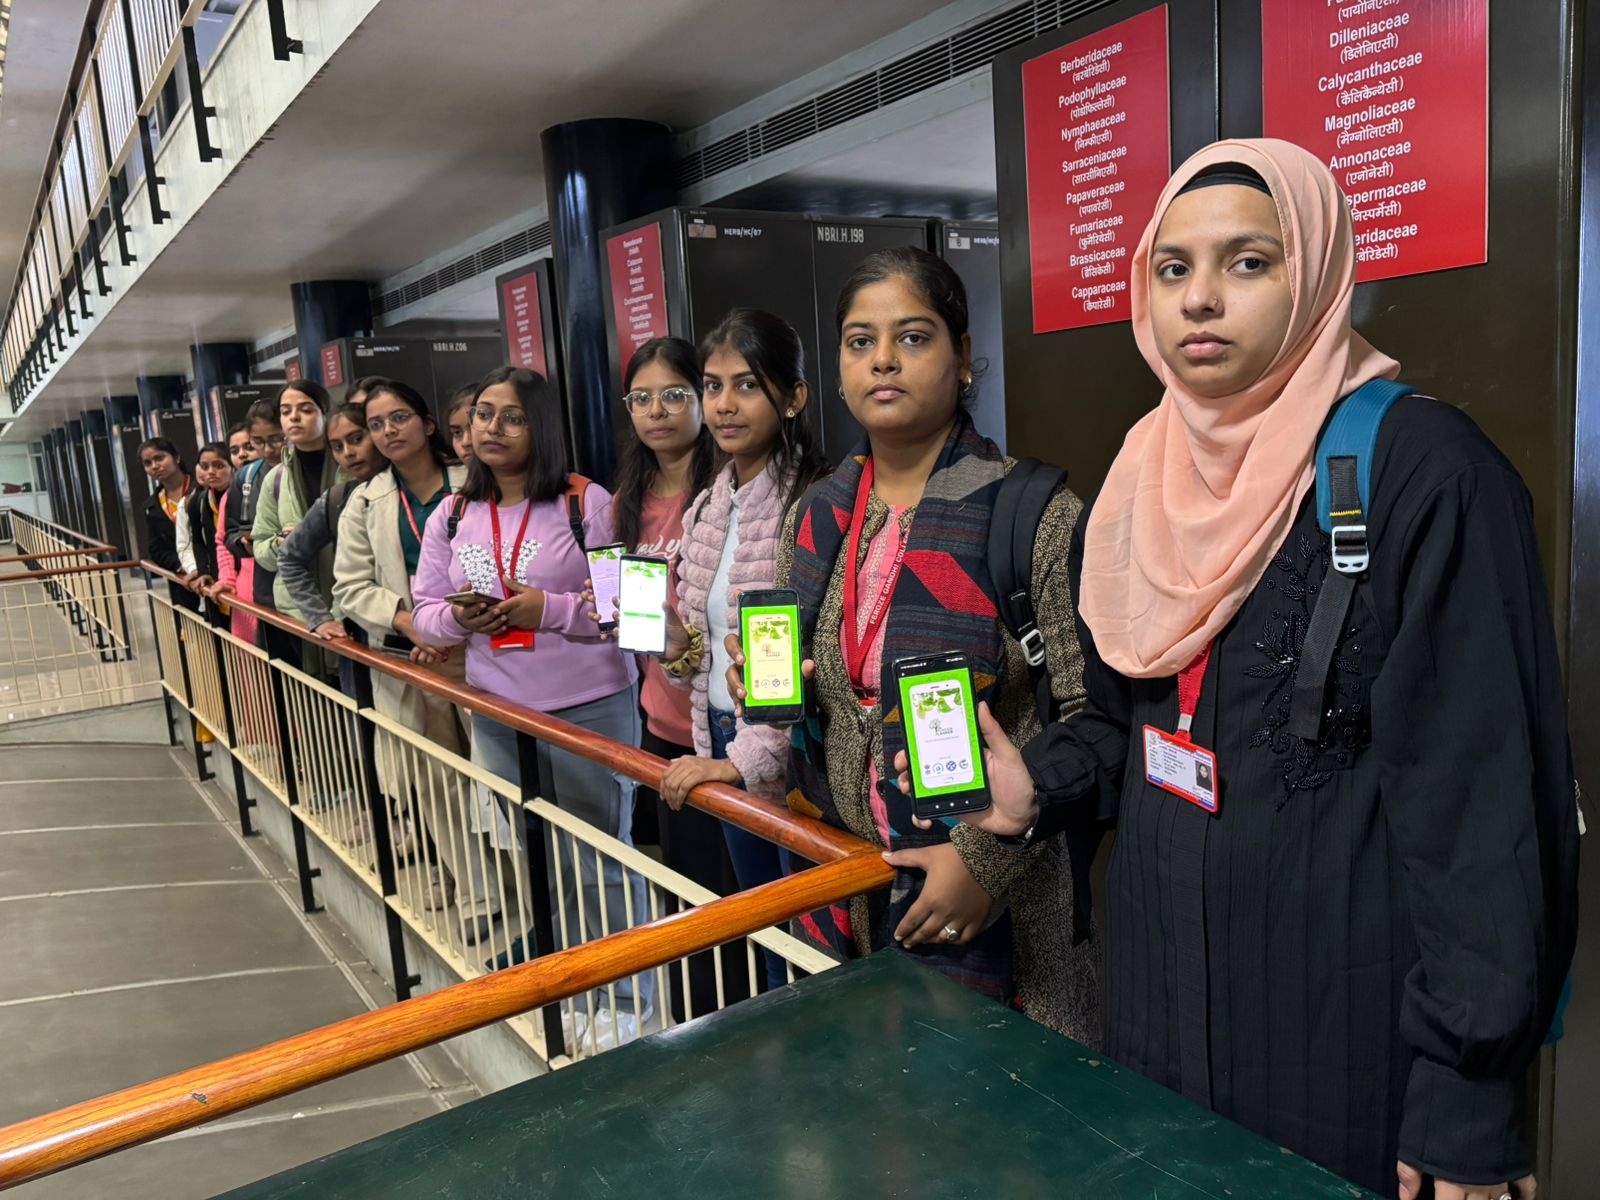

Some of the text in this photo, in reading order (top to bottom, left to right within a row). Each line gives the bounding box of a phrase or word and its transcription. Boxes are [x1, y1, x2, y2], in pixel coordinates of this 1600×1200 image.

[1329, 12, 1410, 48] Dilleniaceae
[1060, 42, 1123, 74] Berberidaceae
[1340, 33, 1399, 65] (डिलेनिएसी)
[1318, 52, 1423, 92] Calycanthaceae
[1058, 75, 1127, 109] Podophyllaceae
[1061, 111, 1126, 142] Nymphaeaceae
[1325, 97, 1416, 132] Magnoliaceae
[1337, 118, 1404, 149] (मैग्नोलिएसी)
[1062, 145, 1127, 173] Sarraceniaceae
[1329, 141, 1412, 171] Annonaceae
[1346, 162, 1394, 186] (एनोनेसी)
[1066, 181, 1125, 205] Papaveraceae
[1345, 178, 1426, 208] spermaceae
[1069, 215, 1124, 236] Fumariaceae
[1069, 247, 1126, 267] Brassicaceae
[1071, 280, 1126, 300] Capparaceae
